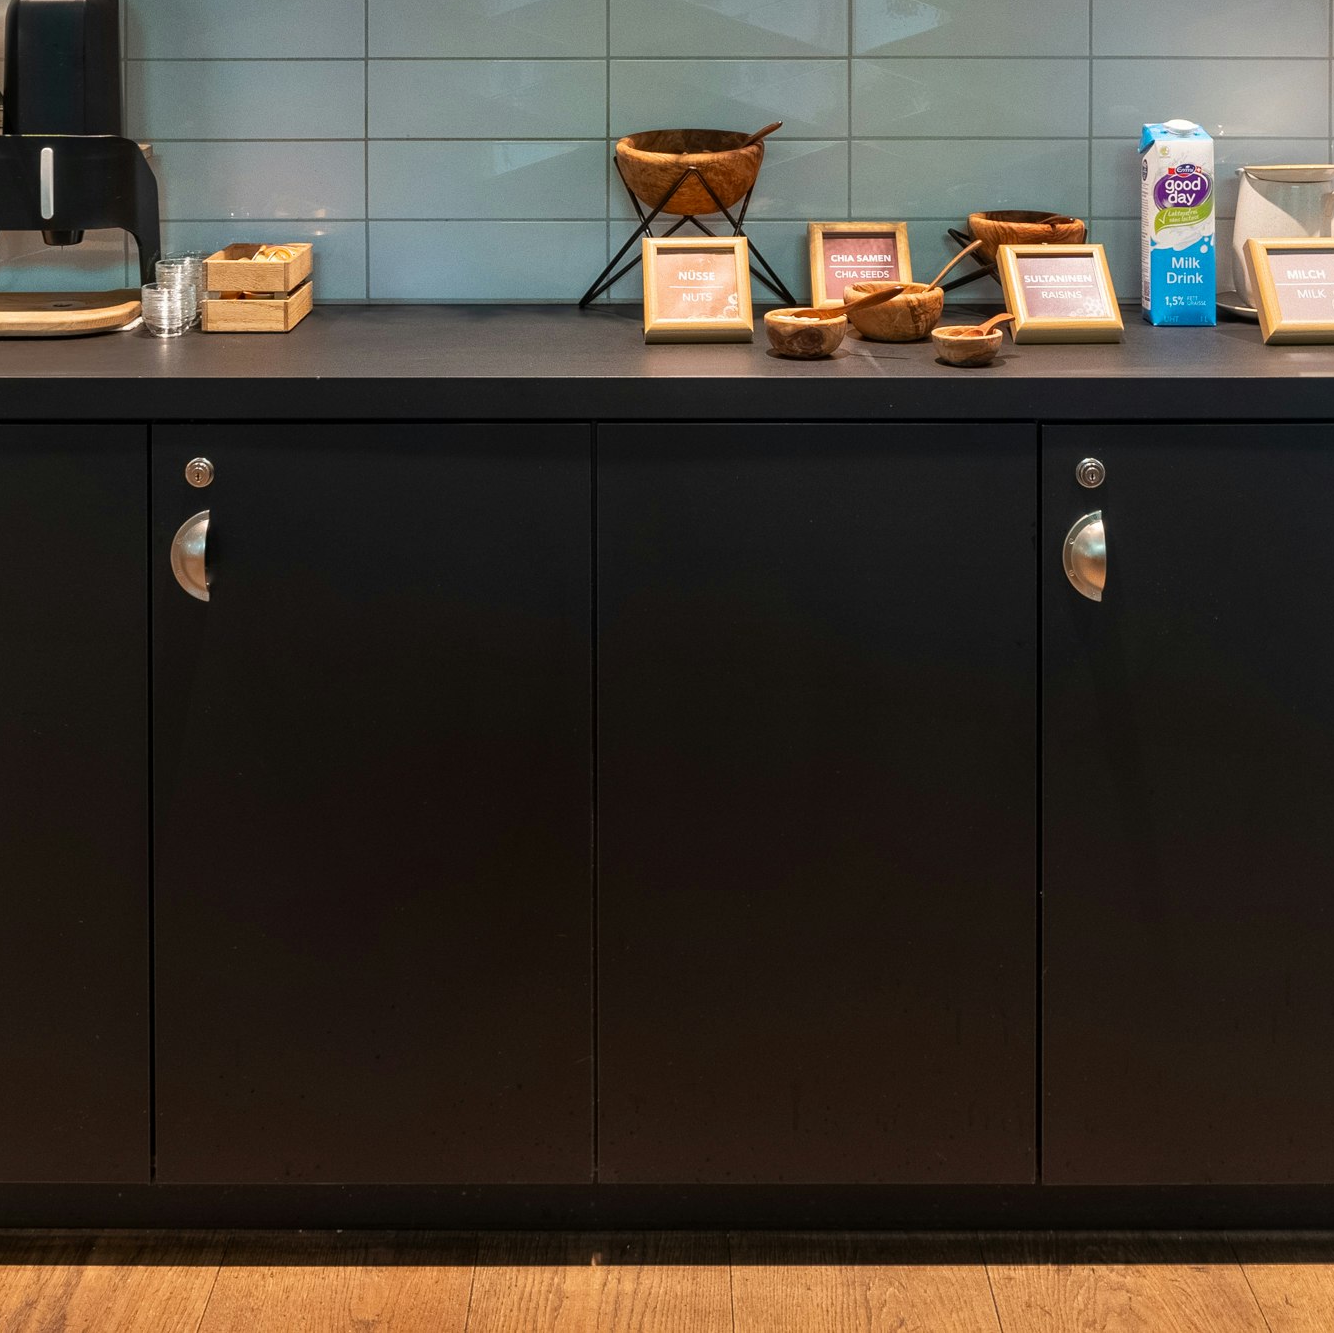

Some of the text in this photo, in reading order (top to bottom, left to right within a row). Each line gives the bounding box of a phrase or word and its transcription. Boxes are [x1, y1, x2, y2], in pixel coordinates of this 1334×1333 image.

[1176, 165, 1195, 173] Emmi
[1165, 177, 1201, 194] good
[1168, 191, 1196, 206] day
[830, 254, 891, 262] CHIA SAMEN
[1171, 257, 1200, 269] Milk
[678, 269, 716, 281] NÜSSE
[834, 270, 890, 279] CHIA SEEDS
[1023, 274, 1092, 283] SULTANINEN
[1166, 272, 1203, 284] Drink
[1287, 269, 1326, 279] MILCH
[682, 292, 713, 302] NUTS
[1041, 291, 1082, 299] RAISINS
[1296, 289, 1327, 299] MILK
[1165, 296, 1184, 307] 1,5%
